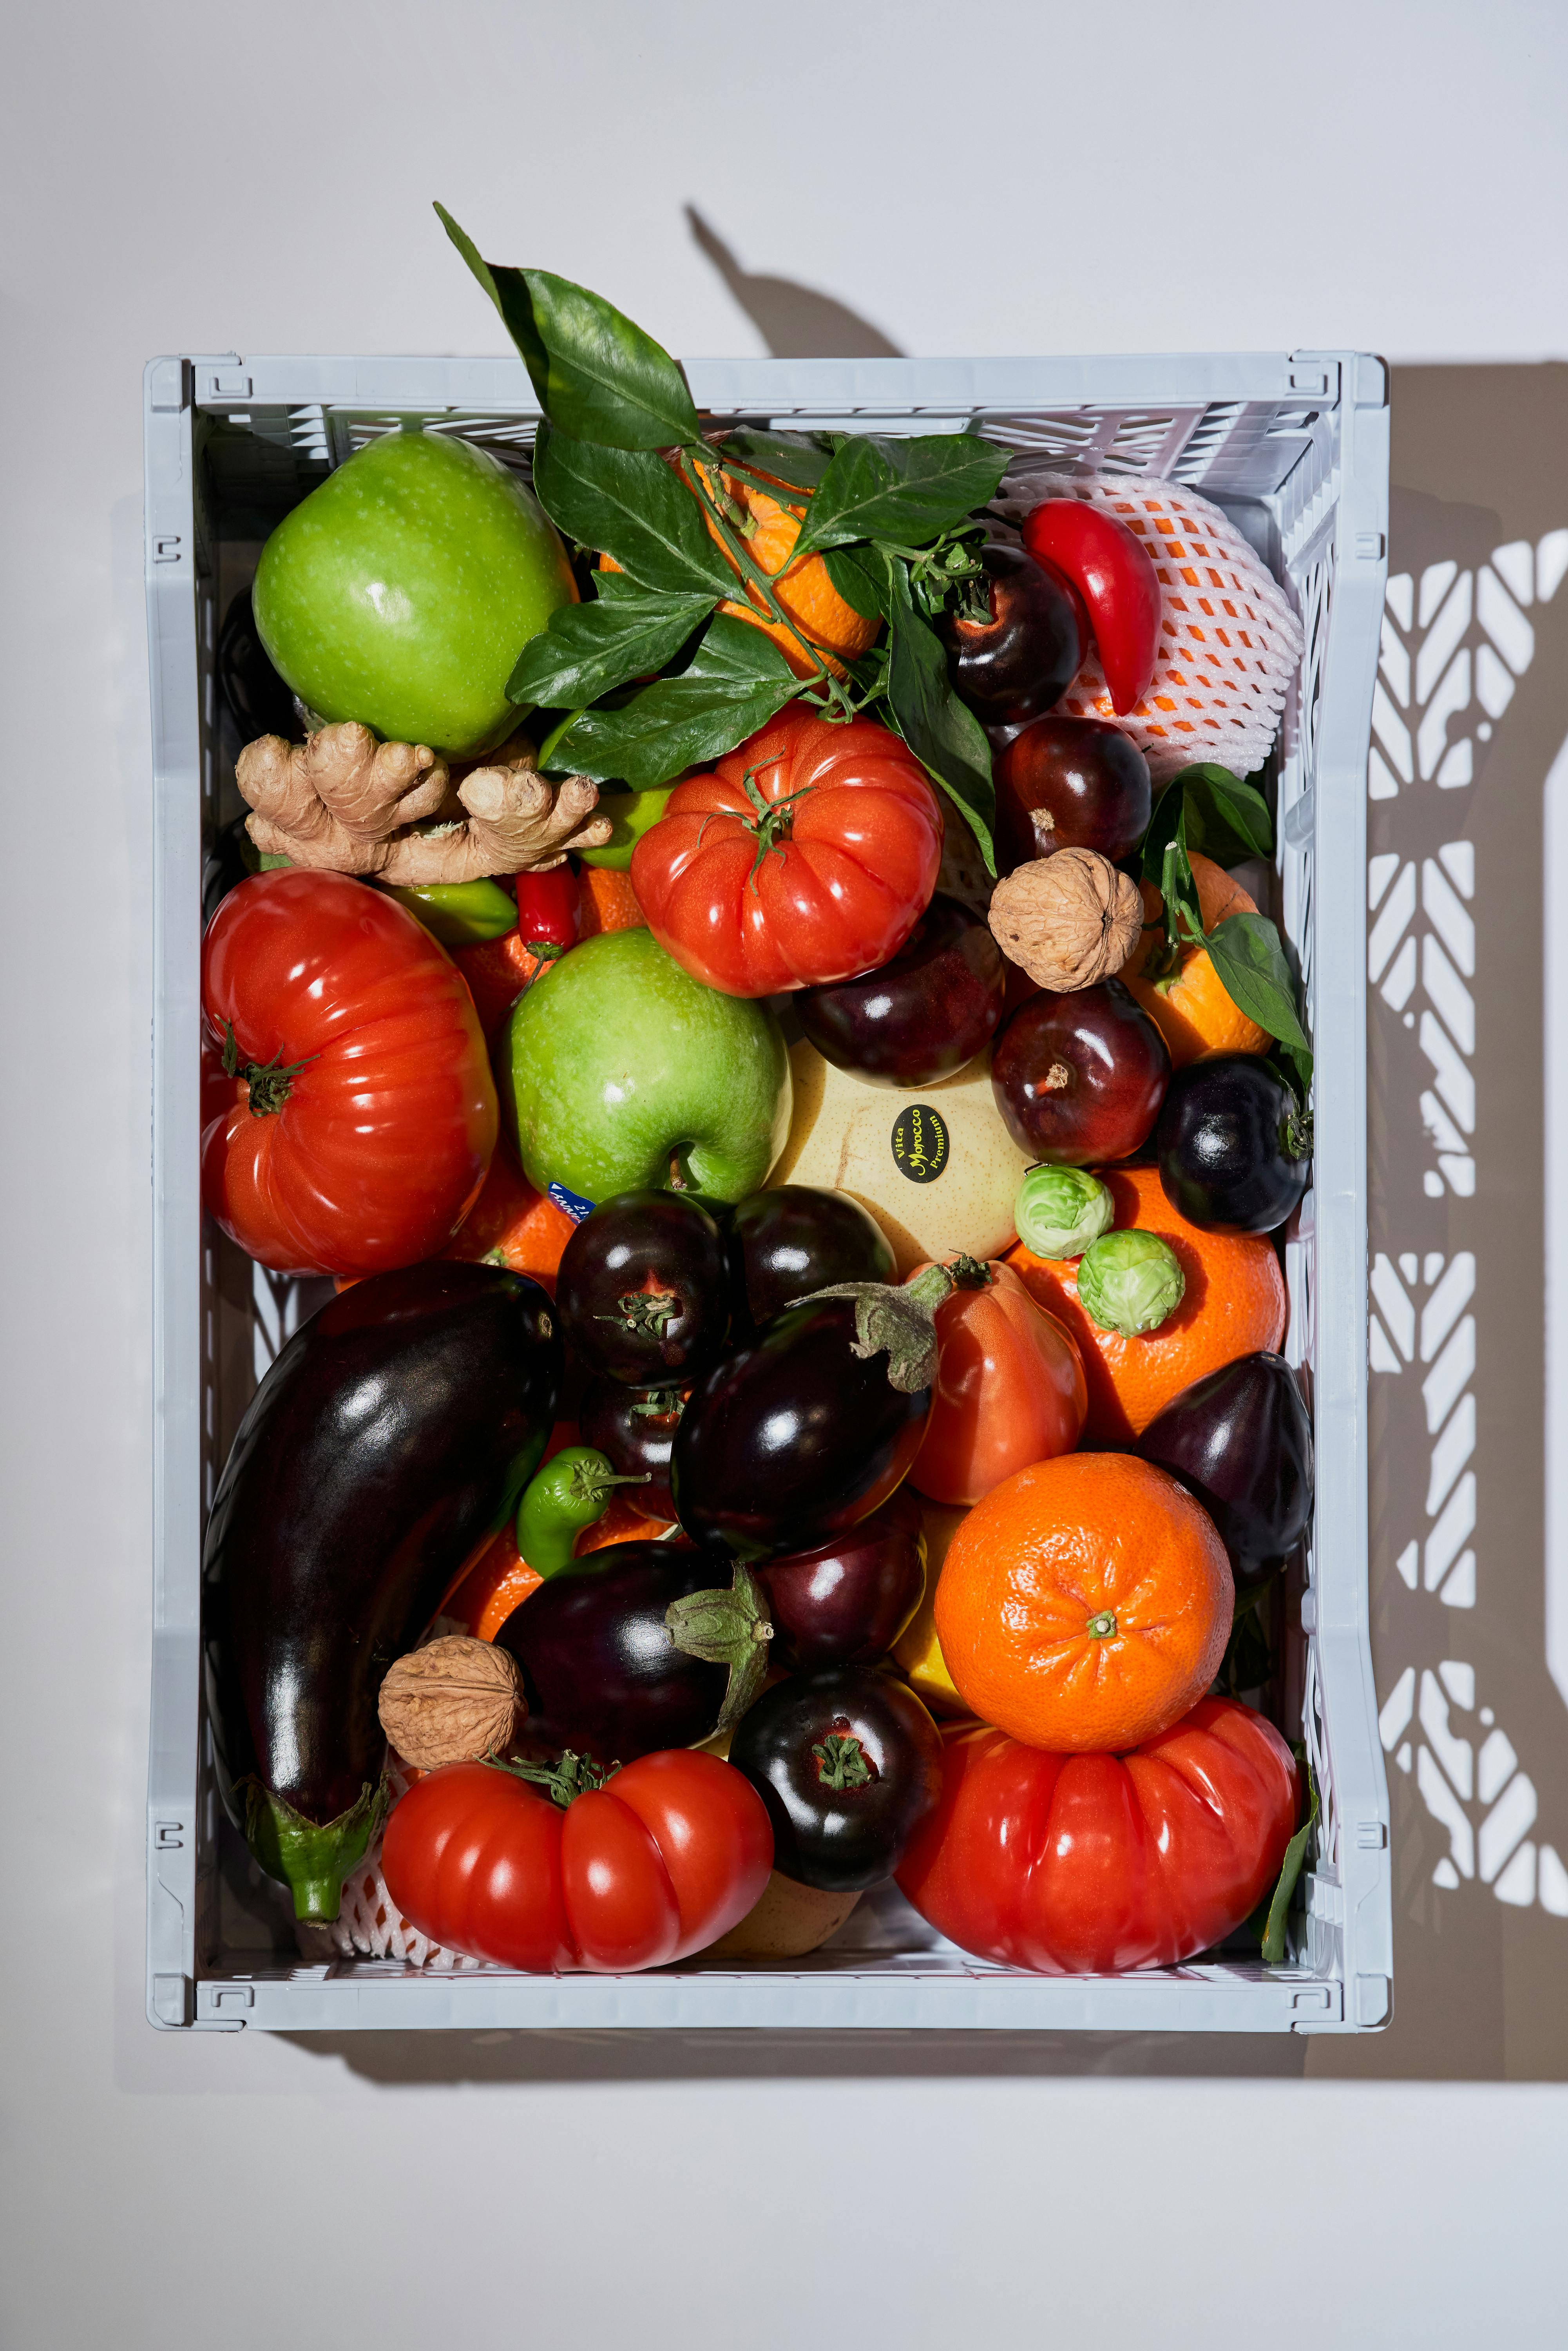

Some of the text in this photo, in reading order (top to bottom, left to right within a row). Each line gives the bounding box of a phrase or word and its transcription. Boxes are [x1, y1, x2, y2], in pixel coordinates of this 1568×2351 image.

[895, 1127, 905, 1159] Vita
[908, 1109, 929, 1176] Morocco
[929, 1115, 944, 1169] Premium
[550, 1192, 581, 1223] ANNY
